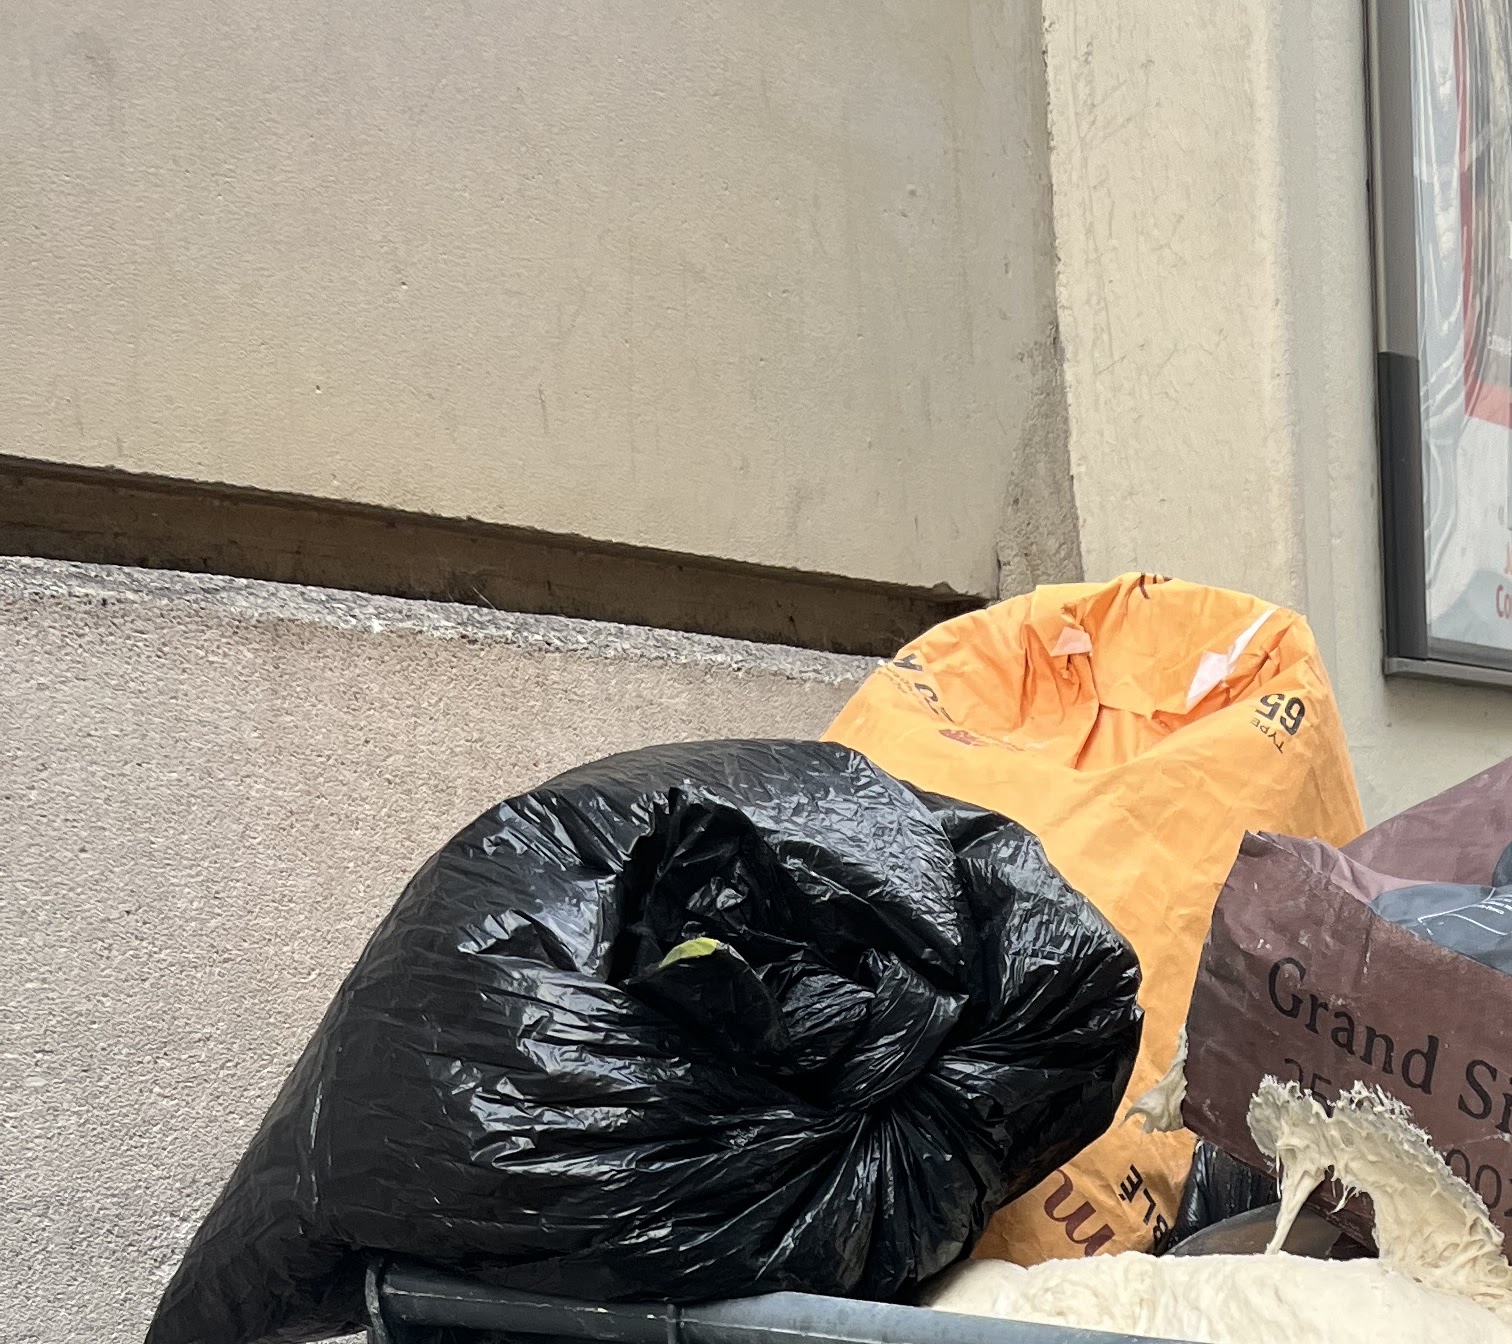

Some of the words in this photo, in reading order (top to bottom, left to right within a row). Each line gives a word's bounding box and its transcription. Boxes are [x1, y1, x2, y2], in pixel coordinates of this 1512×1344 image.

[1250, 717, 1285, 754] TYPE
[1255, 693, 1306, 736] 65
[1268, 957, 1439, 1095] Grand
